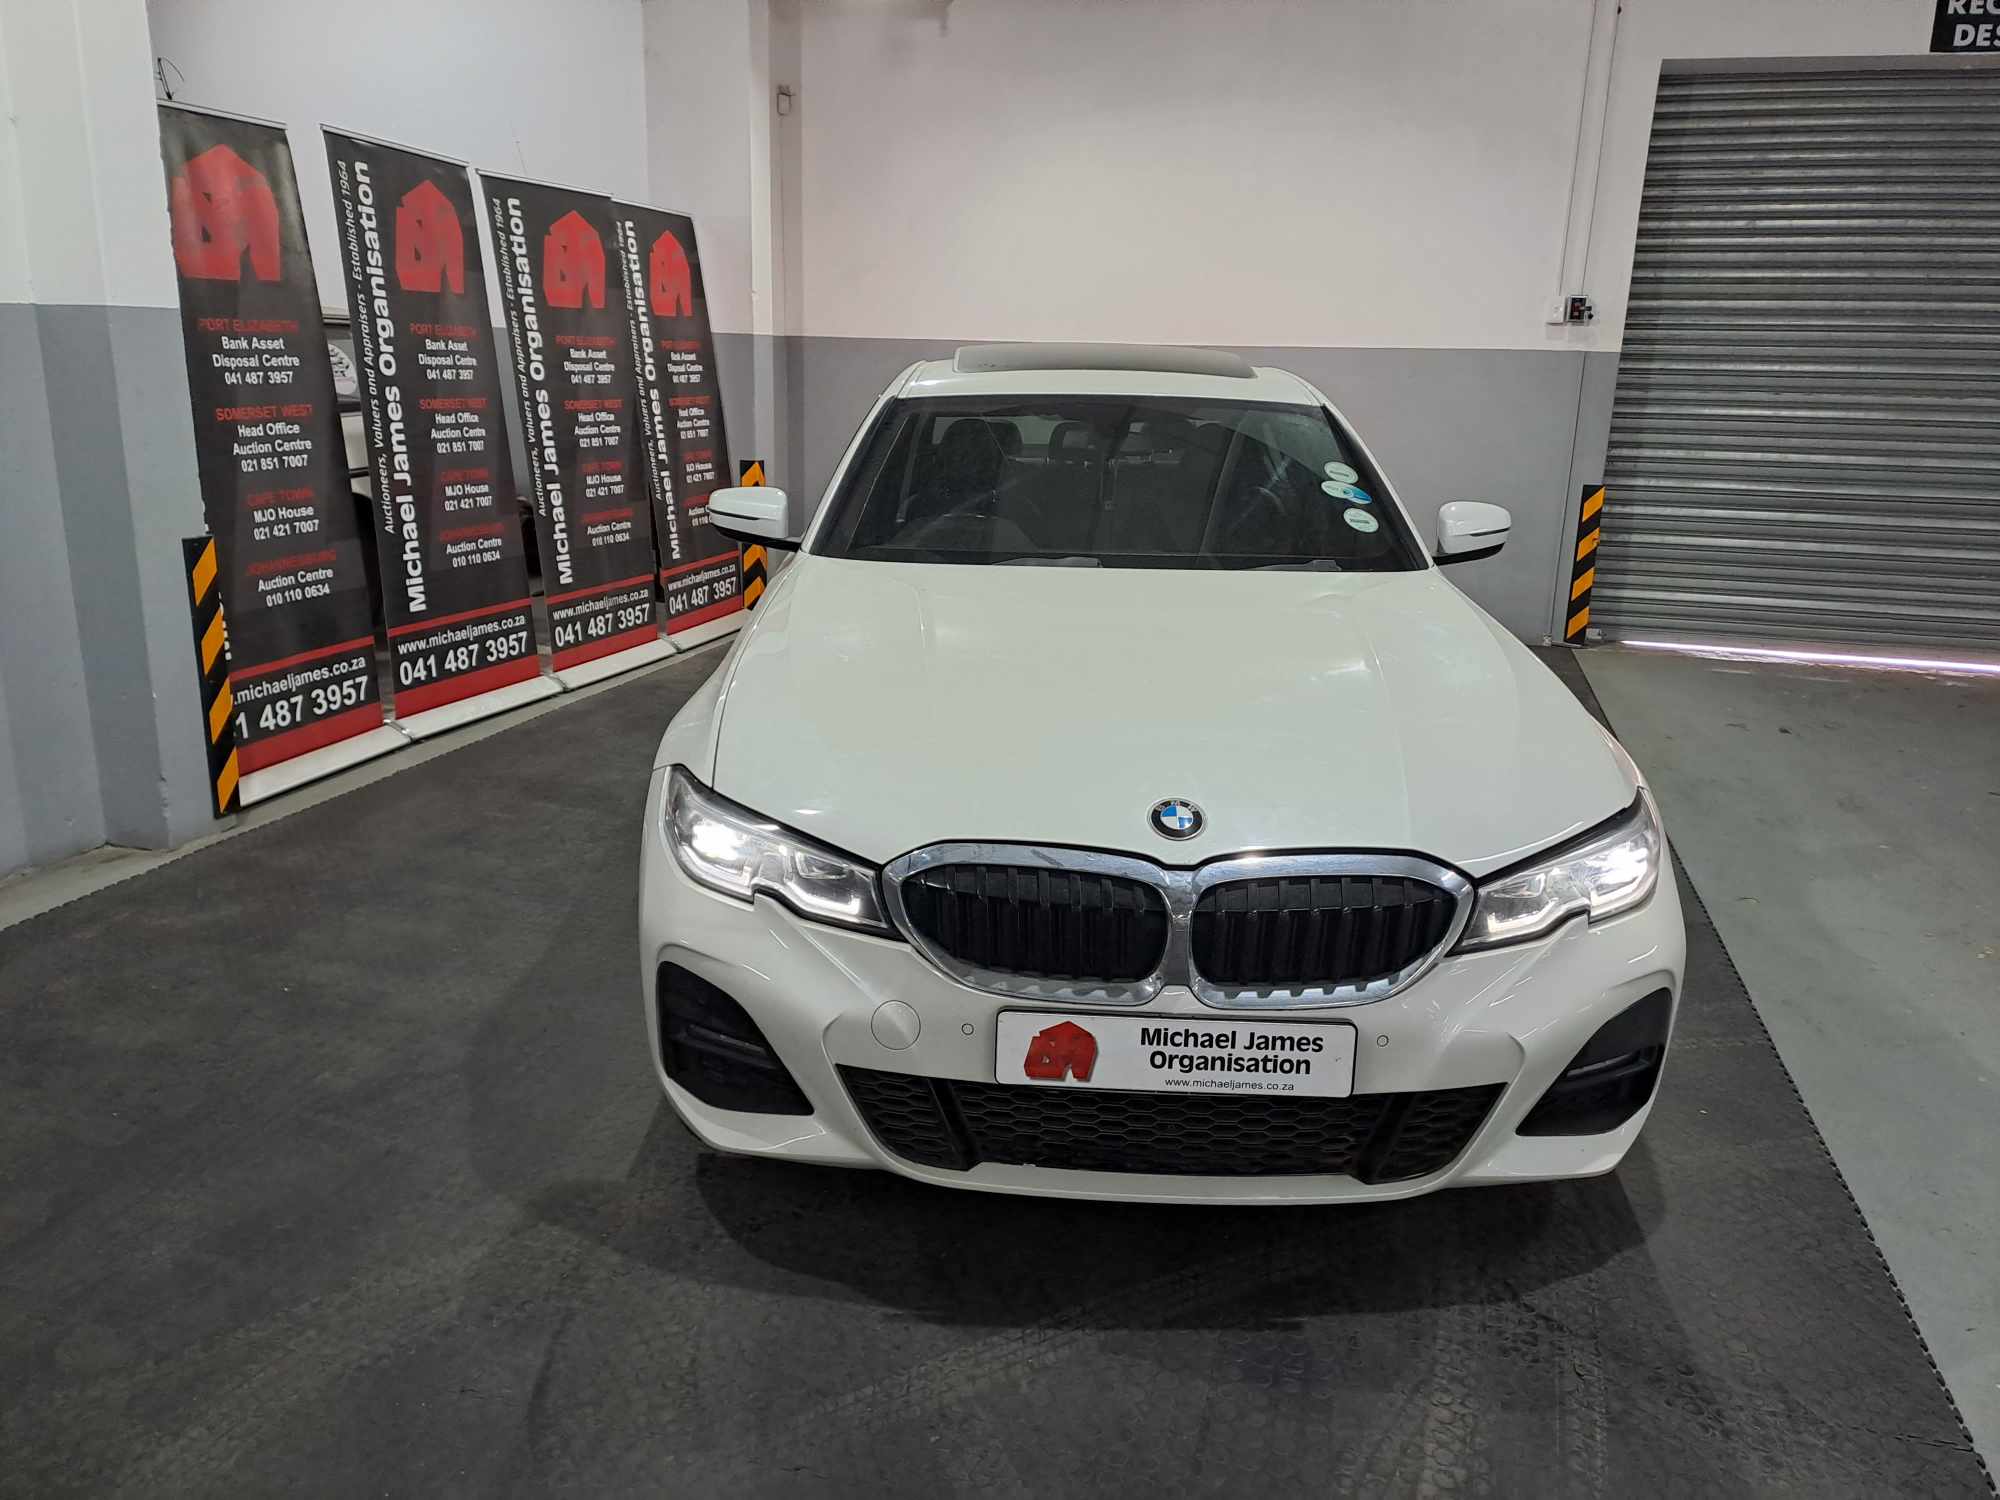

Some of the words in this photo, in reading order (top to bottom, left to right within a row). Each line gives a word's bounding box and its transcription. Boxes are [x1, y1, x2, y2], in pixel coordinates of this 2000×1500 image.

[337, 160, 352, 196] 1964
[344, 198, 363, 281] Established
[354, 161, 397, 377] Organisation
[497, 229, 515, 300] Established
[507, 198, 545, 381] Organisation
[624, 220, 656, 381] Organisation
[221, 336, 249, 349] Bank
[252, 337, 285, 350] Asset
[356, 293, 374, 366] Appraisers
[510, 307, 527, 373] Appraisers
[425, 339, 446, 350] Bank
[212, 354, 259, 370] Disposal
[262, 354, 300, 367] Centre
[418, 354, 453, 367] Disposal
[224, 372, 242, 385] 041
[245, 372, 264, 384] 487
[268, 371, 293, 384] 3957
[365, 368, 378, 396] and
[426, 369, 441, 380] 041
[442, 369, 456, 380] 487
[518, 373, 529, 399] and
[215, 406, 277, 421] SOMERSET
[371, 399, 384, 449] Valuers
[435, 413, 455, 424] Head
[457, 412, 479, 423] Office
[524, 400, 536, 443] Valuers
[650, 388, 668, 465] James
[237, 424, 264, 437] Head
[266, 422, 300, 435] Office
[385, 385, 412, 487] James
[431, 428, 461, 440] Auction
[463, 427, 486, 438] Centre
[535, 388, 559, 475] James
[233, 441, 272, 456] Auction
[275, 438, 312, 452] Centre
[436, 442, 451, 454] 021
[452, 442, 466, 453] 851
[241, 460, 258, 472] 021
[261, 457, 279, 470] 851
[282, 454, 308, 468] 7007
[378, 452, 395, 534] Auctioneers,
[445, 485, 463, 496] MJO
[464, 484, 489, 495] House
[530, 446, 547, 517] Auctioneers,
[253, 509, 276, 523] MJO
[278, 506, 314, 518] House
[444, 500, 458, 511] 021
[460, 498, 474, 509] 421
[660, 470, 681, 560] Michael
[253, 526, 270, 540] 021
[273, 523, 291, 536] 421
[294, 519, 320, 533] 7007
[545, 482, 573, 585] Michael
[395, 494, 427, 613] Michael
[446, 541, 476, 555] Auction
[477, 538, 502, 549] Centre
[452, 556, 466, 567] 010
[467, 553, 481, 565] 110
[482, 550, 501, 562] 0634
[258, 575, 295, 592] Auction
[297, 568, 333, 583] Centre
[266, 591, 284, 607] 010
[285, 588, 302, 604] 110
[304, 583, 330, 598] 0634
[552, 588, 649, 620] www.michaeljames.co.za
[669, 594, 688, 614] 041
[690, 585, 709, 607] 487
[713, 576, 737, 599] 3957
[397, 615, 525, 654] www.michaeljames.co.za
[555, 621, 582, 647] 041
[587, 613, 613, 637] 487
[617, 603, 650, 629] 3957
[399, 654, 437, 686] 041
[444, 644, 479, 672] 487
[485, 631, 528, 662] 3957
[259, 695, 303, 730] 487
[311, 675, 368, 715] 3957
[1139, 1027, 1237, 1049] Michael
[1243, 1031, 1324, 1053] James
[1149, 1050, 1311, 1075] Organisation
[1165, 1077, 1295, 1092] www.michaeljames.co.za
